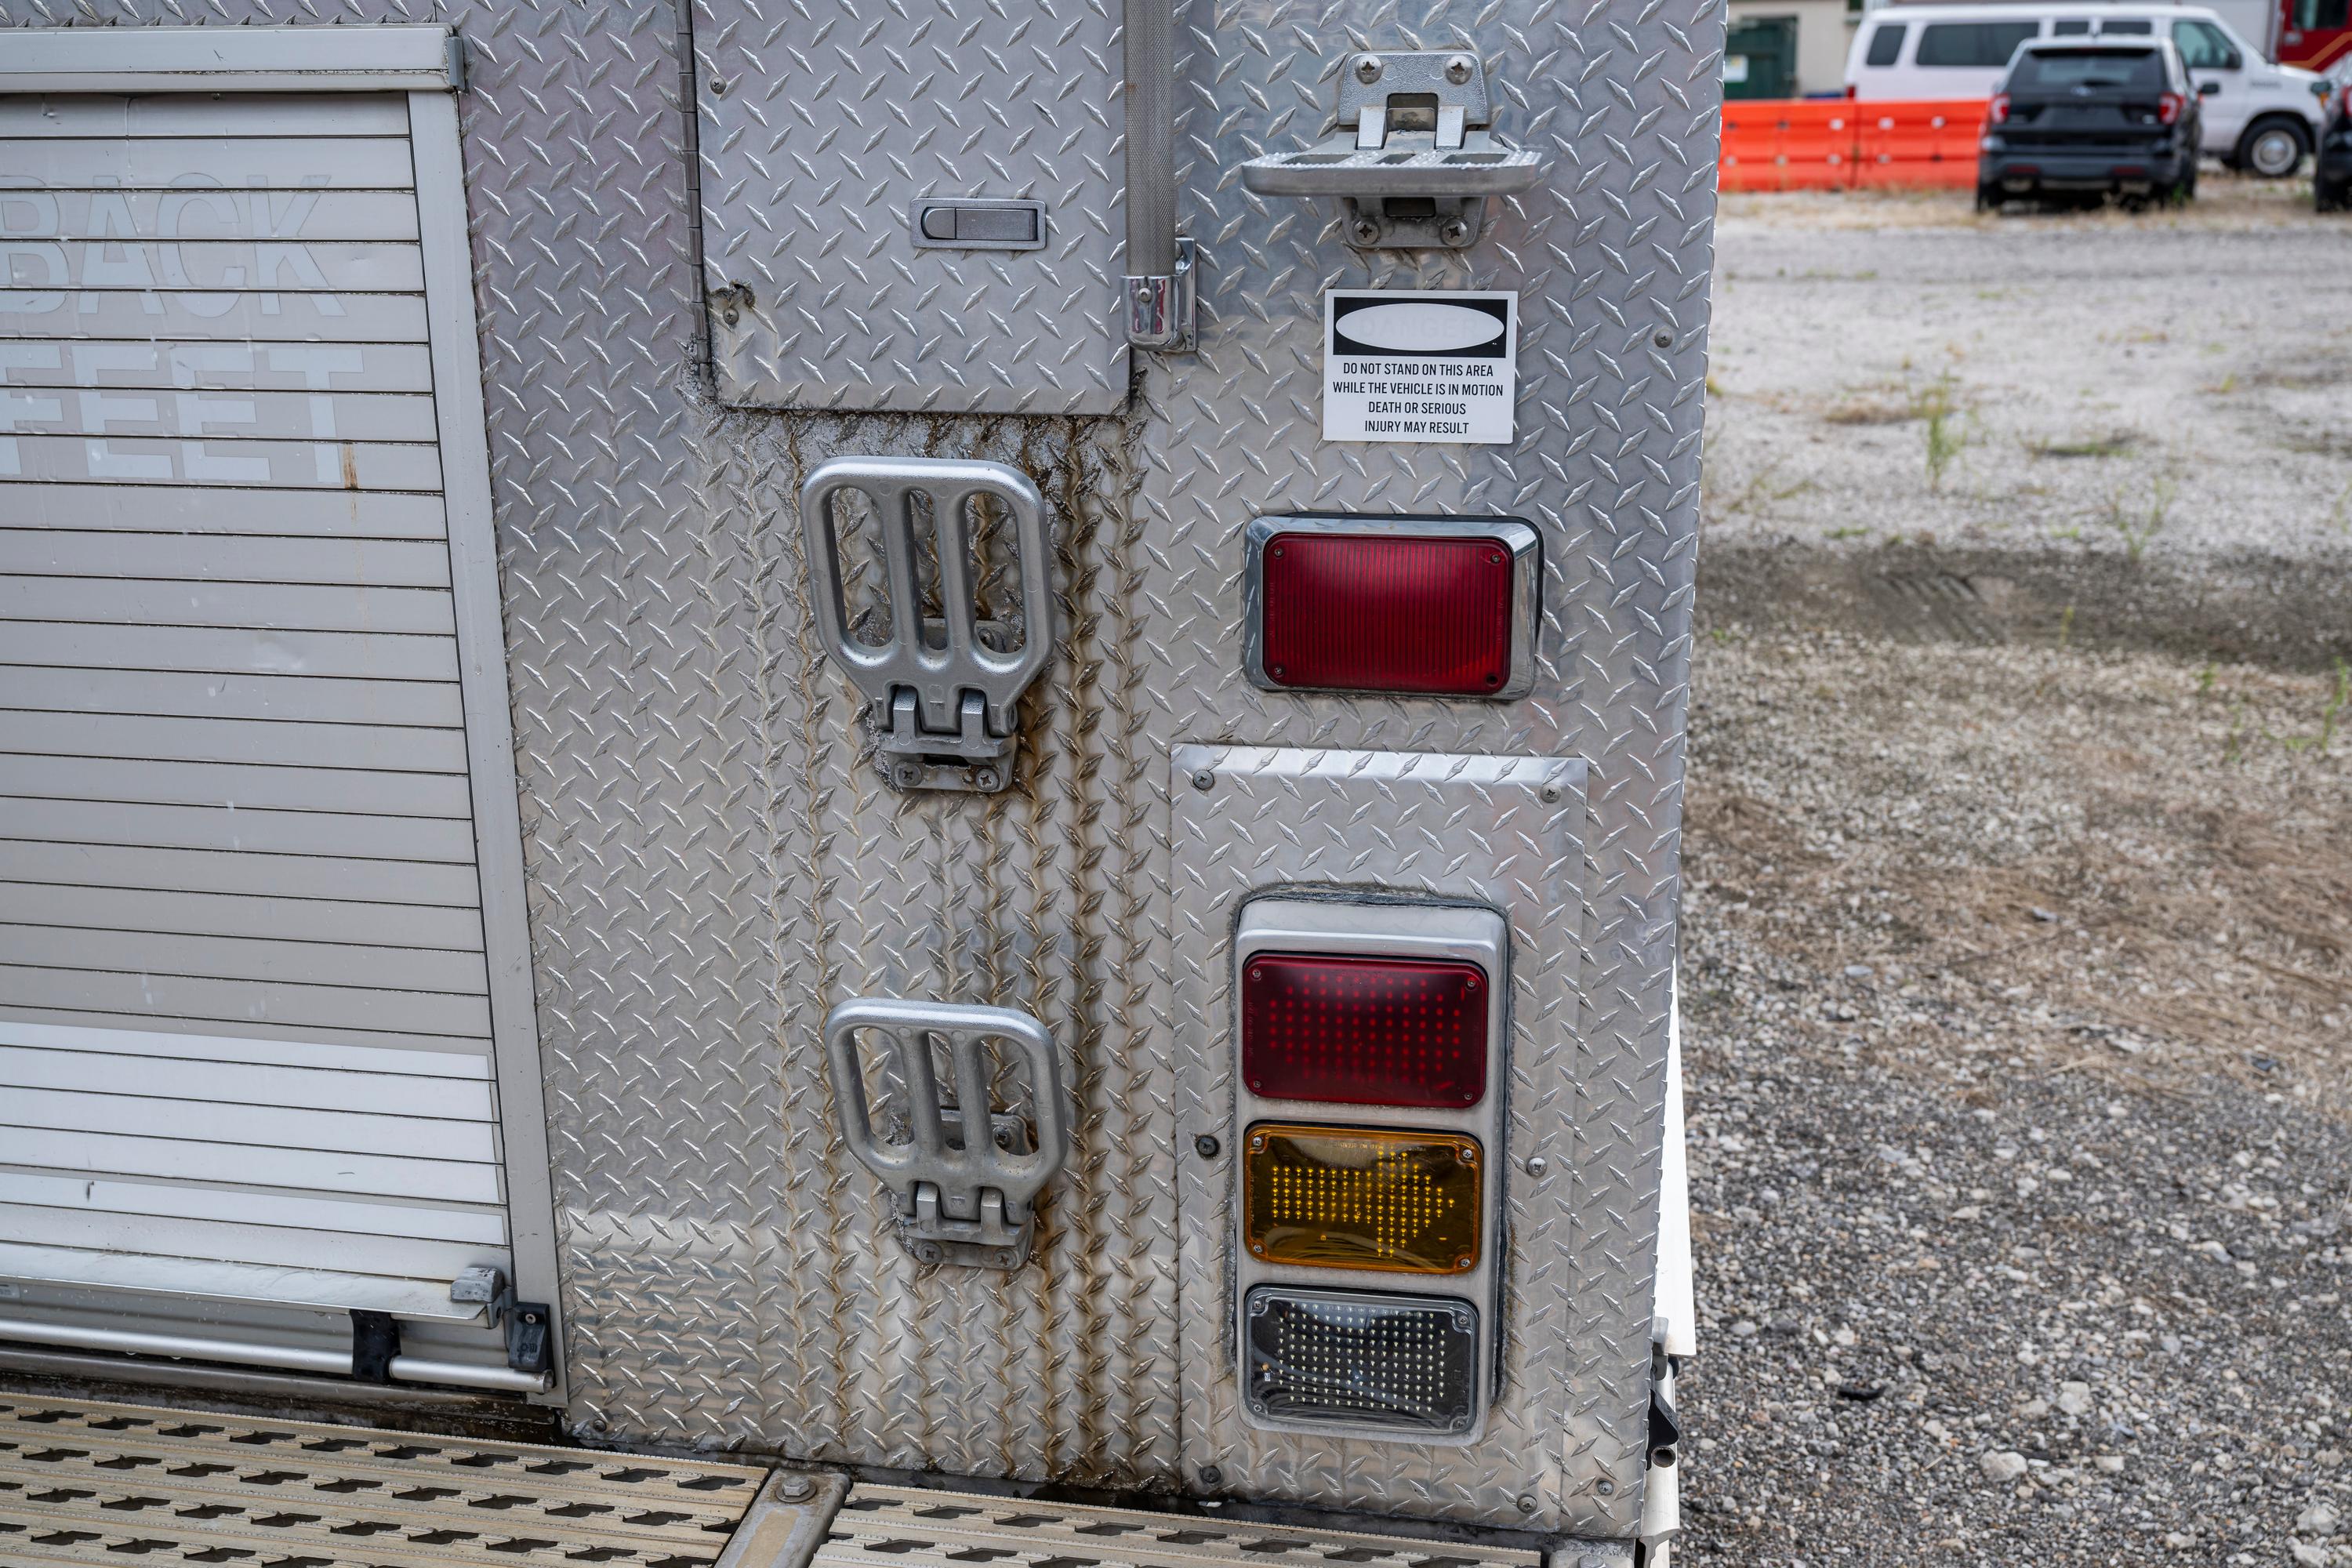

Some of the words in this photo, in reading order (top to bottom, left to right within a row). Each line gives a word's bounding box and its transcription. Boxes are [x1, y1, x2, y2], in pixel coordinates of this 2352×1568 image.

[0, 172, 347, 317] BACK
[1343, 362, 1358, 374] DO
[1360, 362, 1381, 375] NOT
[1384, 363, 1419, 376] STAND
[1421, 364, 1436, 376] ON
[1439, 364, 1463, 376] THIS
[1465, 365, 1494, 376] AREA
[1333, 381, 1366, 394] WHILE
[1367, 382, 1388, 394] THE
[1390, 383, 1433, 395] VEHICLE
[1436, 383, 1446, 395] IS
[1448, 383, 1459, 395] IN
[1461, 384, 1503, 396] MOTION
[0, 345, 365, 483] FEET
[1368, 401, 1402, 413] DEATH
[1404, 402, 1418, 414] OR
[1421, 402, 1466, 415] SERIOUS
[1365, 420, 1401, 432] INJURY
[1403, 421, 1427, 433] MAY
[1429, 422, 1469, 434] RESULT
